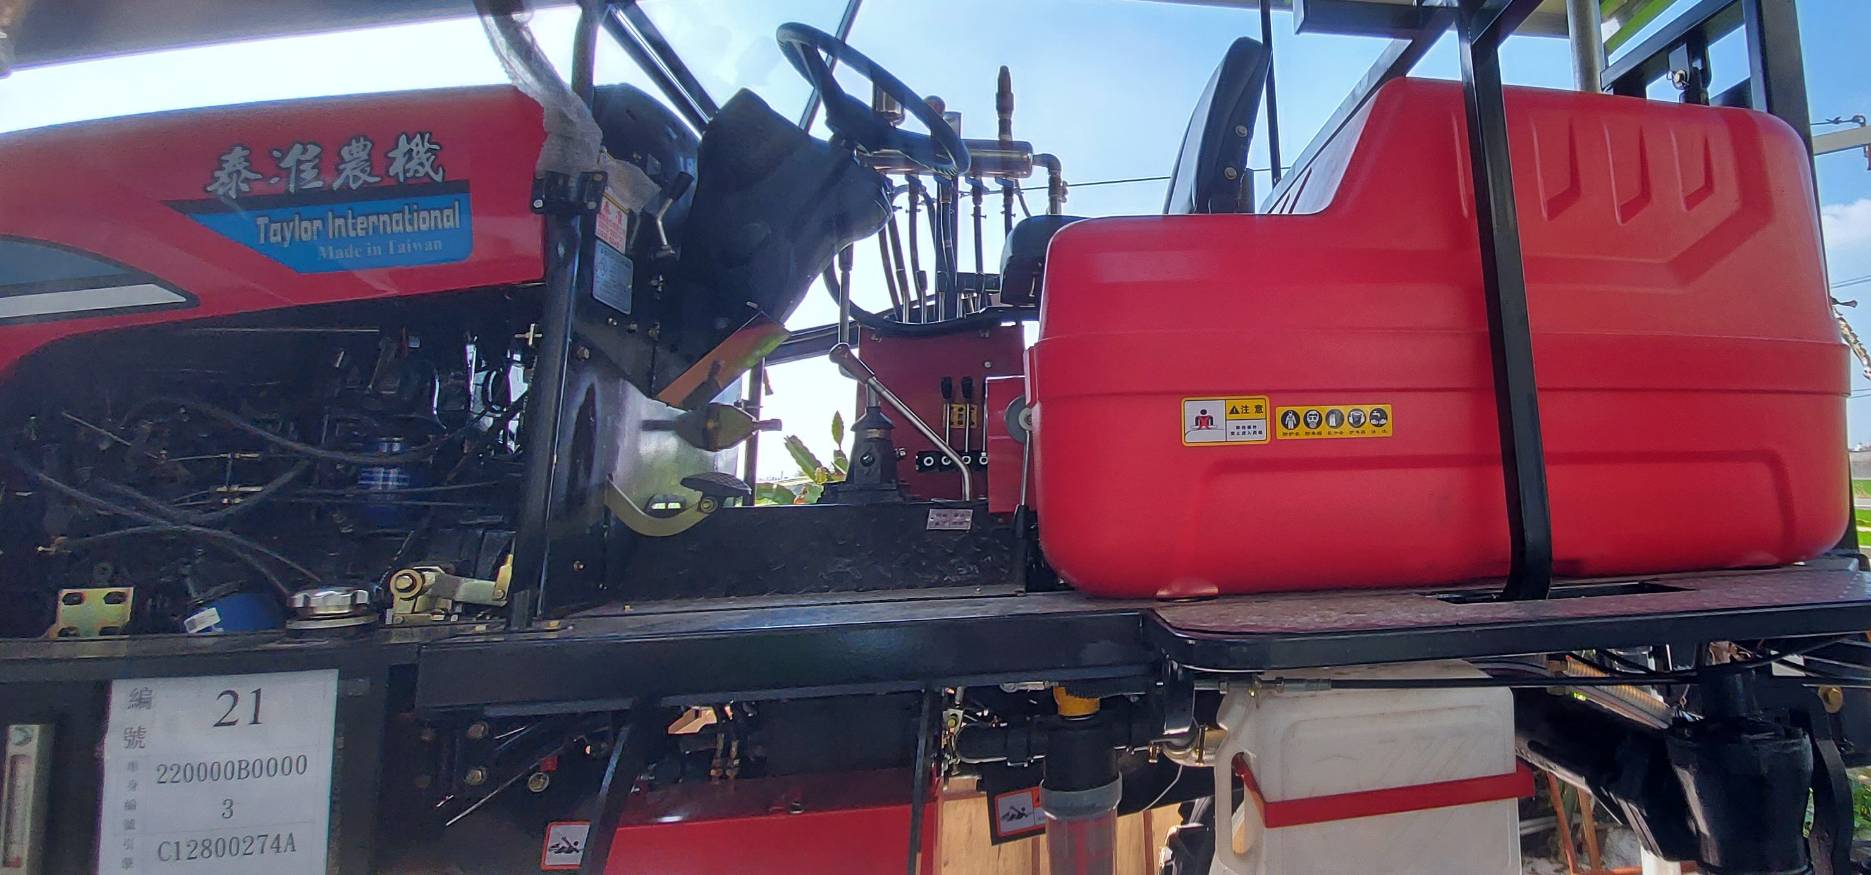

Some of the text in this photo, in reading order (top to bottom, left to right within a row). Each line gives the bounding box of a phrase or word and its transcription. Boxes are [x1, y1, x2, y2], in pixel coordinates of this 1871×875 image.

[256, 201, 460, 248] Taylor International
[320, 239, 443, 260] Made in Taiwan
[1241, 404, 1264, 414] 注意
[123, 686, 153, 750] 編號
[213, 688, 264, 727] 21
[156, 754, 308, 784] 220000B0000
[222, 799, 234, 819] 3
[158, 832, 297, 862] C12800274A
